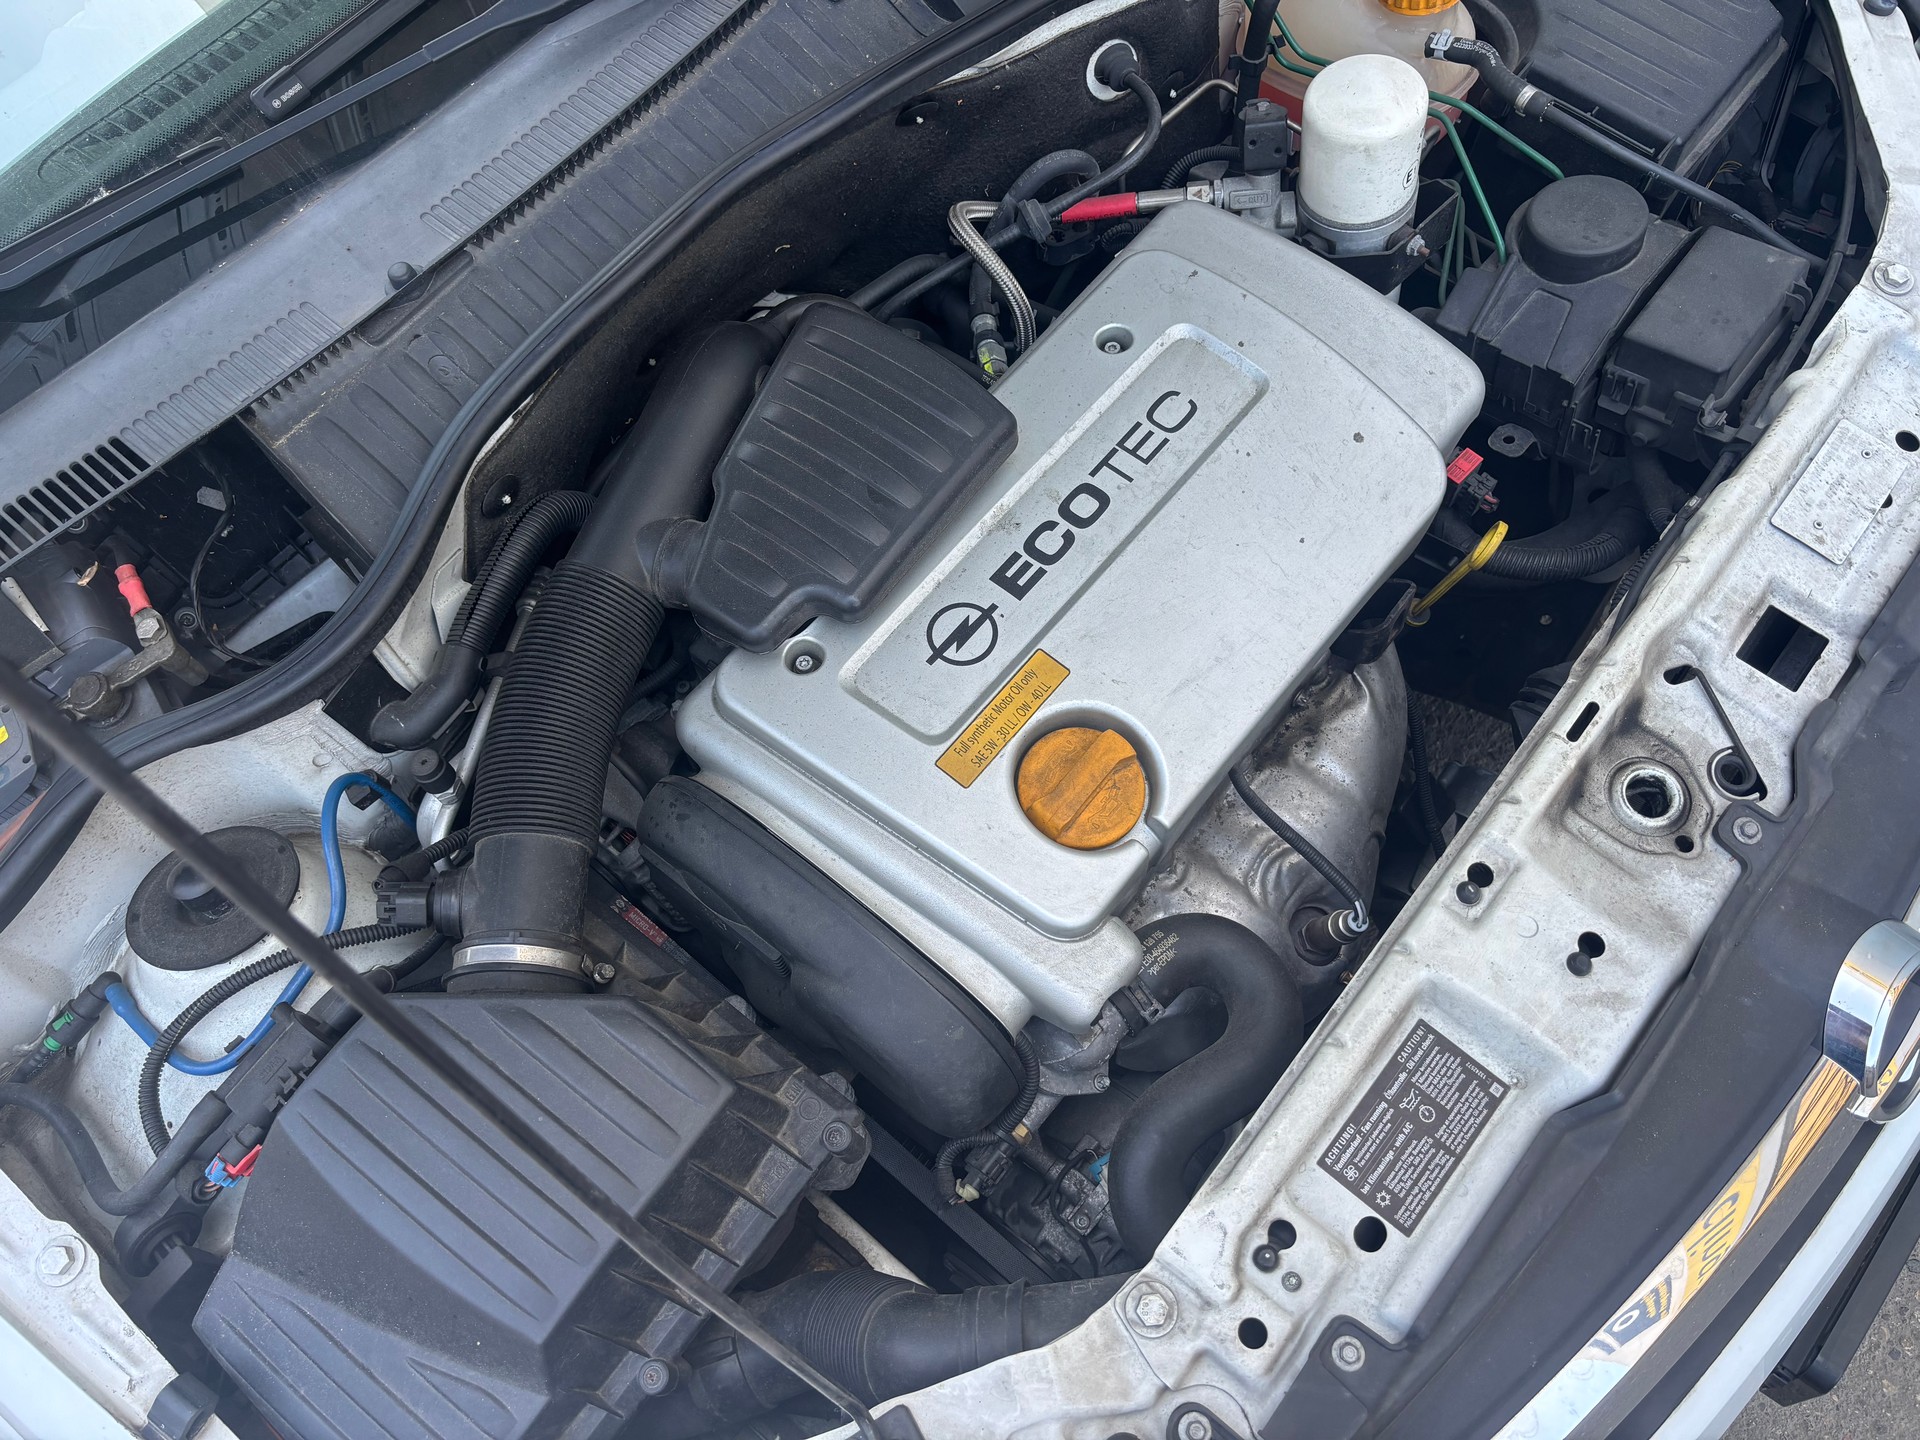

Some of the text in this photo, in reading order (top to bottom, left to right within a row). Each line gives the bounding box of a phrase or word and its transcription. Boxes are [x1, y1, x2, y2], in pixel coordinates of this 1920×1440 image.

[989, 390, 1199, 601] ECOTEC
[953, 666, 1040, 758] Full synthetic Motor Oil only
[969, 749, 989, 768] SAE
[982, 737, 999, 754] 5W
[996, 725, 1011, 739] 30
[1004, 715, 1020, 731] LL
[1029, 688, 1044, 702] 40
[1037, 679, 1052, 693] LL
[1382, 1068, 1408, 1099] Ölkontrolle
[1405, 1059, 1415, 1070] Oil
[1410, 1047, 1424, 1062] level
[1419, 1032, 1434, 1050] check
[1396, 1025, 1426, 1063] CAUTION!
[1323, 1122, 1356, 1165] ACHTUNG!
[1332, 1133, 1362, 1172] Ventilatorlauf
[1360, 1120, 1372, 1133] Fan
[1367, 1099, 1388, 1124] running
[1359, 1181, 1371, 1194] bei
[1366, 1148, 1396, 1185] Klimaanlage
[1392, 1132, 1406, 1147] with
[1401, 1121, 1413, 1135] A/C
